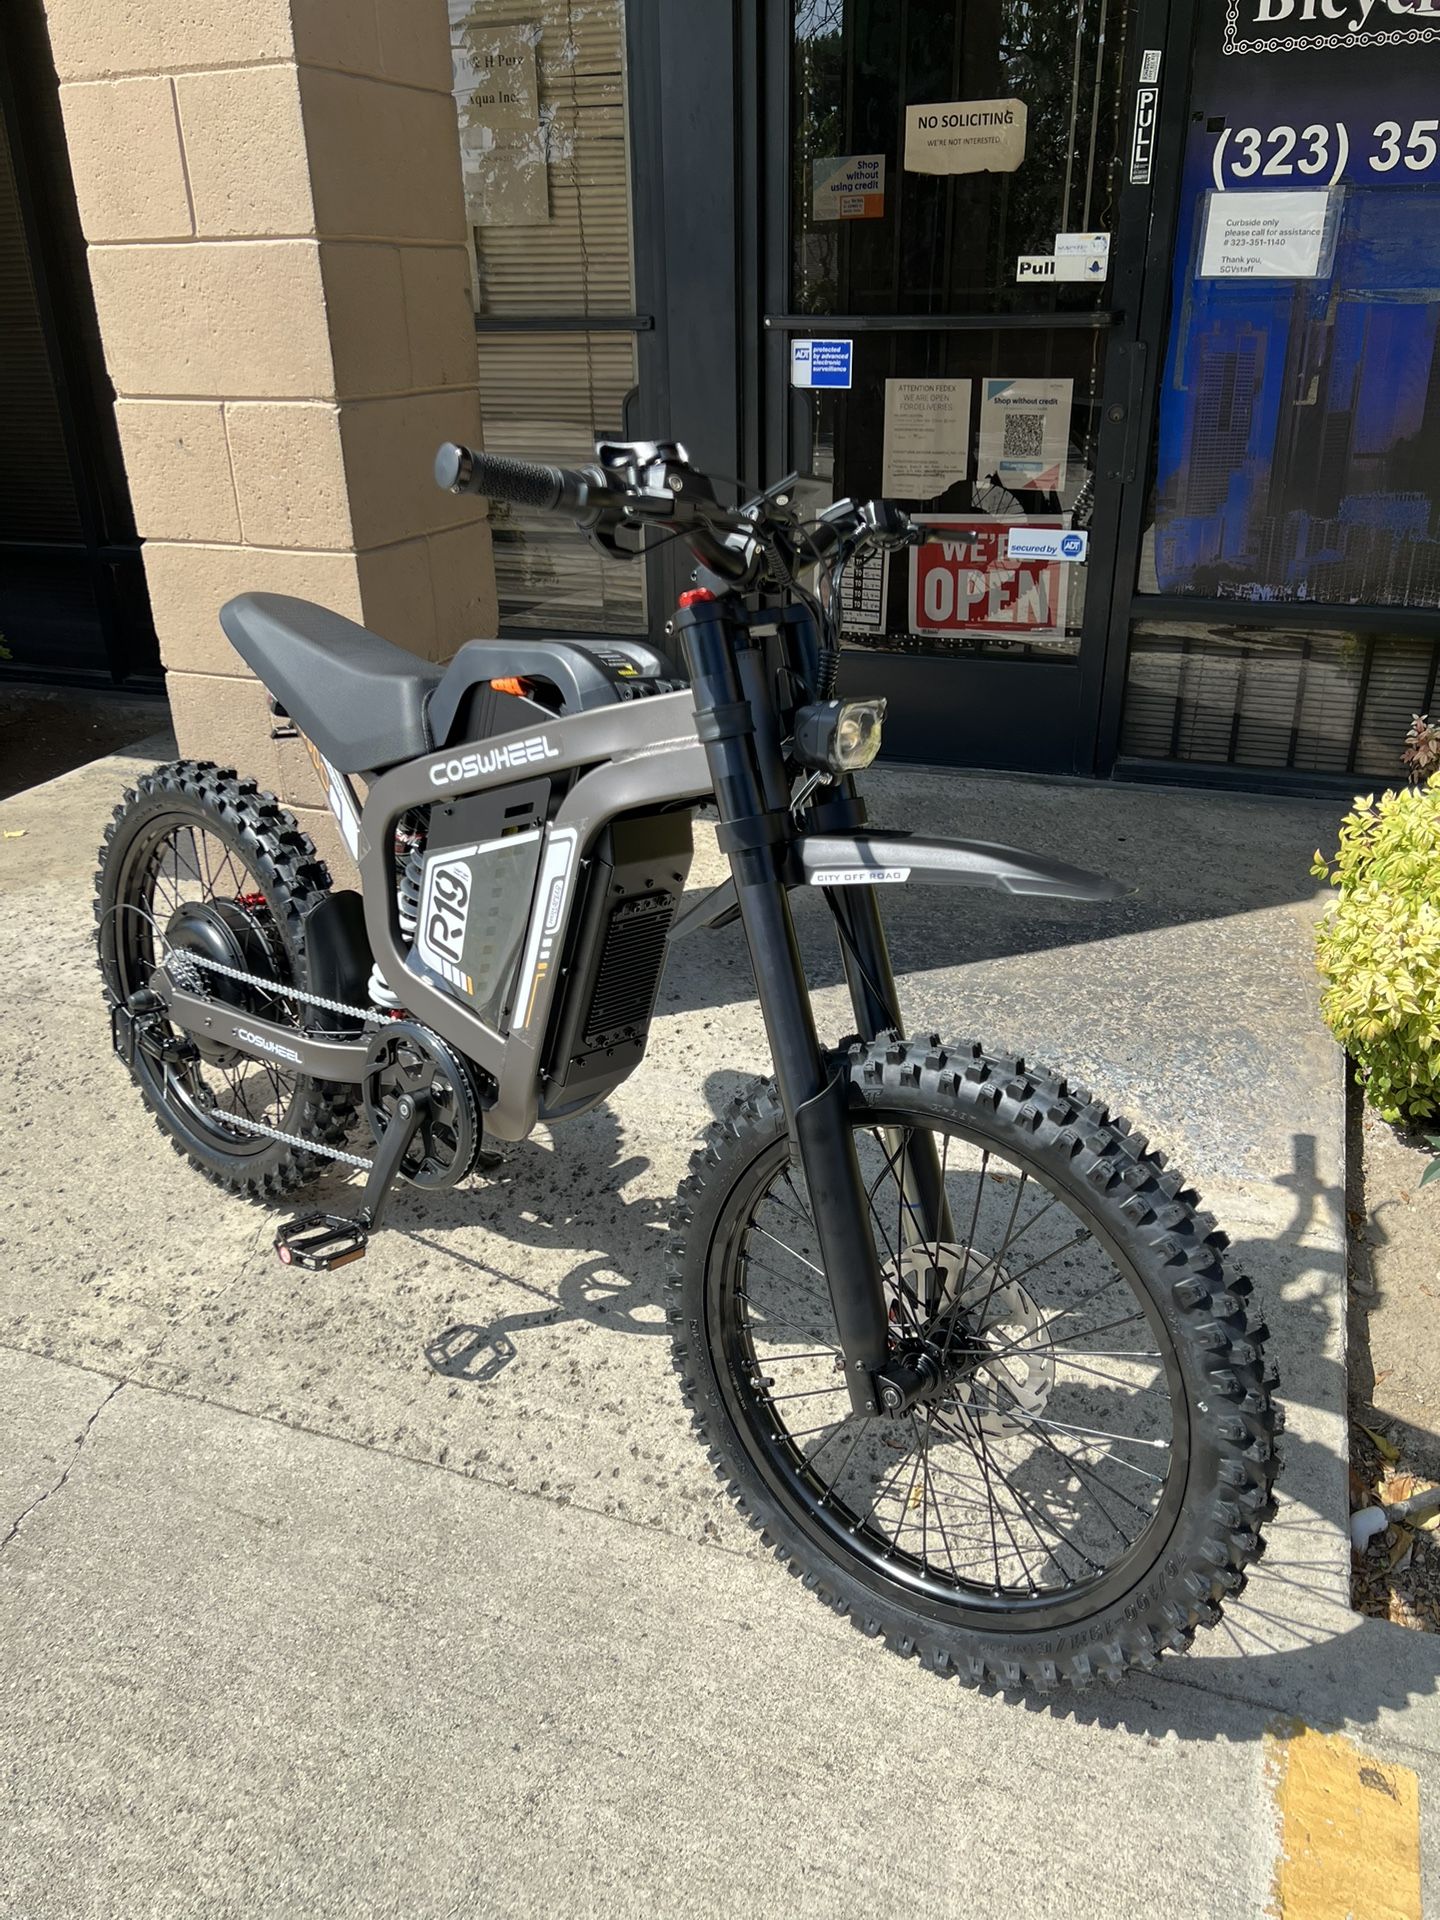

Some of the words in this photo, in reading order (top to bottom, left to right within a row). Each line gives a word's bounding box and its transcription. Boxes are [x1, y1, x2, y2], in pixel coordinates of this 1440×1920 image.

[485, 56, 494, 68] H
[918, 116, 938, 129] NO
[941, 110, 1014, 128] SOLICITING
[1136, 92, 1154, 162] PULL
[962, 136, 1000, 145] INTERESTED
[1212, 122, 1349, 191] (323)
[857, 160, 880, 170] Shop
[846, 171, 879, 180] without
[830, 182, 853, 192] using
[854, 180, 878, 190] credit
[1226, 218, 1261, 227] Curbside
[1262, 219, 1280, 228] only
[1224, 228, 1250, 238] please
[1251, 228, 1266, 236] call
[1266, 228, 1278, 236] for
[1230, 238, 1286, 246] 323-351-1140
[1221, 256, 1245, 264] Thank
[1020, 262, 1055, 275] Pull
[796, 349, 810, 360] ADT
[994, 398, 1012, 406] Shop
[1010, 544, 1046, 553] secured
[1046, 544, 1057, 554] by
[1064, 540, 1080, 551] ADT
[924, 566, 1050, 624] OPEN
[429, 736, 559, 786] COSWHEEL
[817, 874, 840, 882] CITY
[870, 872, 901, 880] ROAD
[428, 869, 468, 961] R19
[238, 1028, 303, 1064] COSWHEEL
